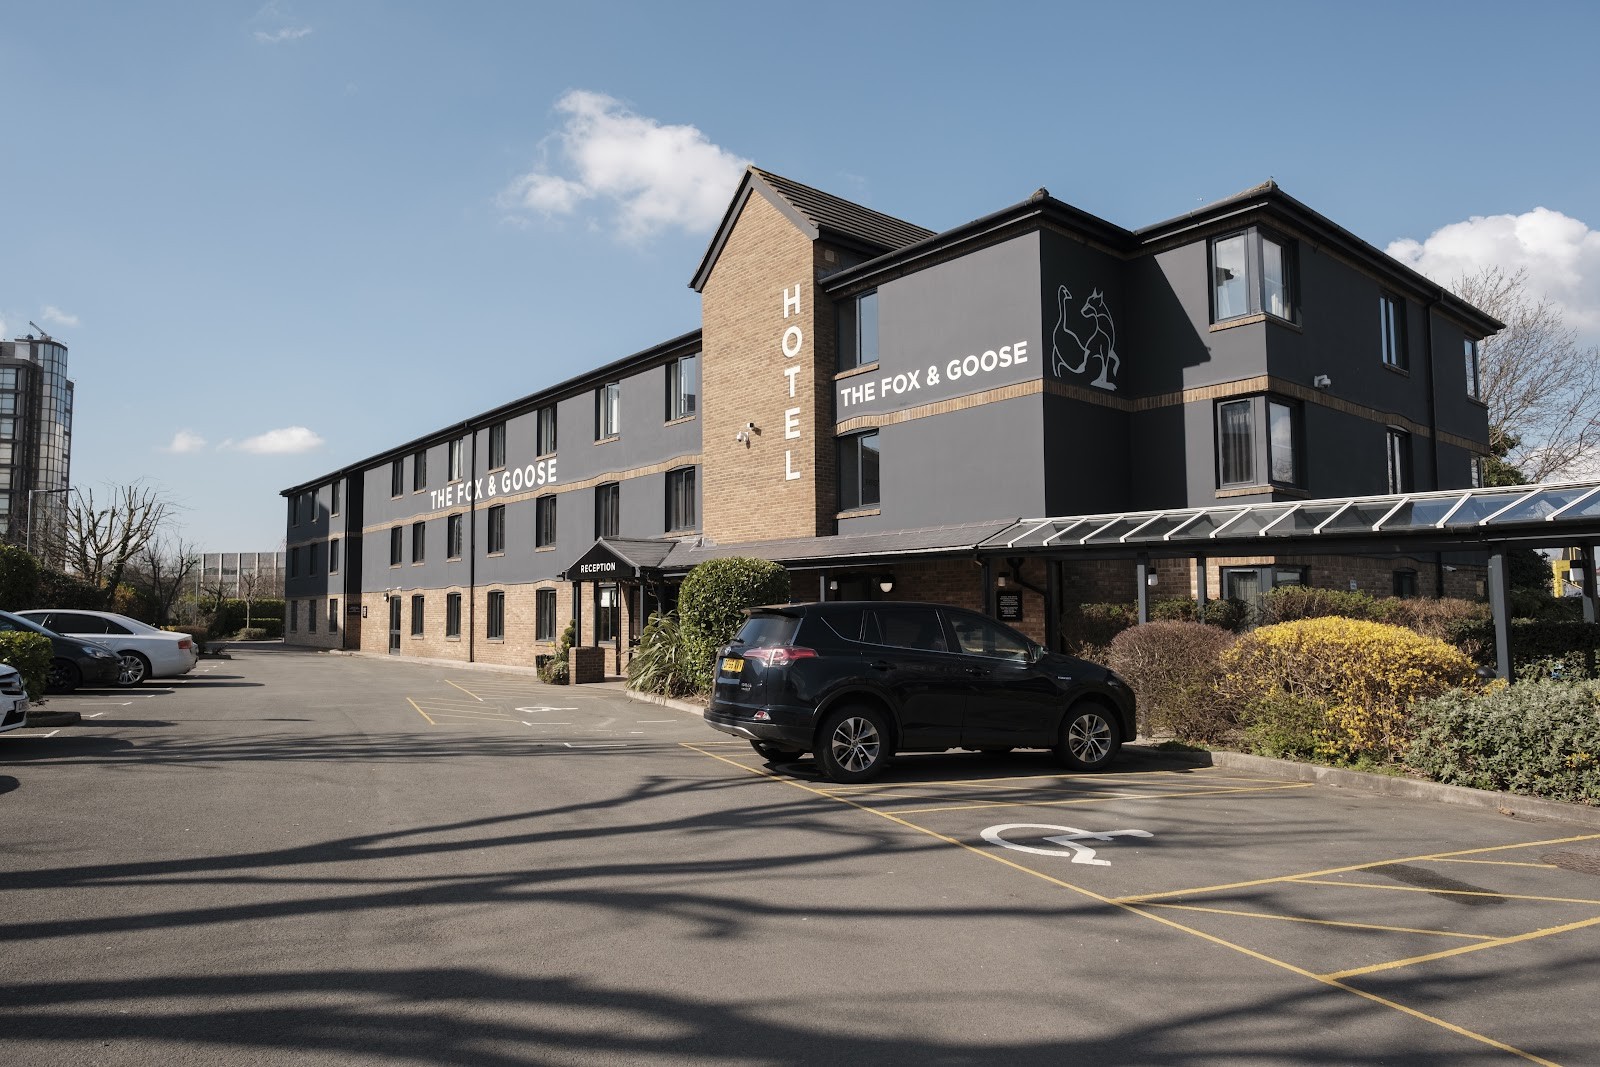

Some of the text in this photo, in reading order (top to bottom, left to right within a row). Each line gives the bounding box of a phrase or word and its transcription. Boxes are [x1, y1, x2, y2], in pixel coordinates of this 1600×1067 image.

[781, 283, 803, 481] HOTEL
[841, 341, 1028, 407] THE FOX & GOOSE
[430, 486, 453, 510] THE
[487, 475, 497, 497] &
[501, 458, 557, 493] GOOSE
[580, 562, 616, 573] RECEPTION
